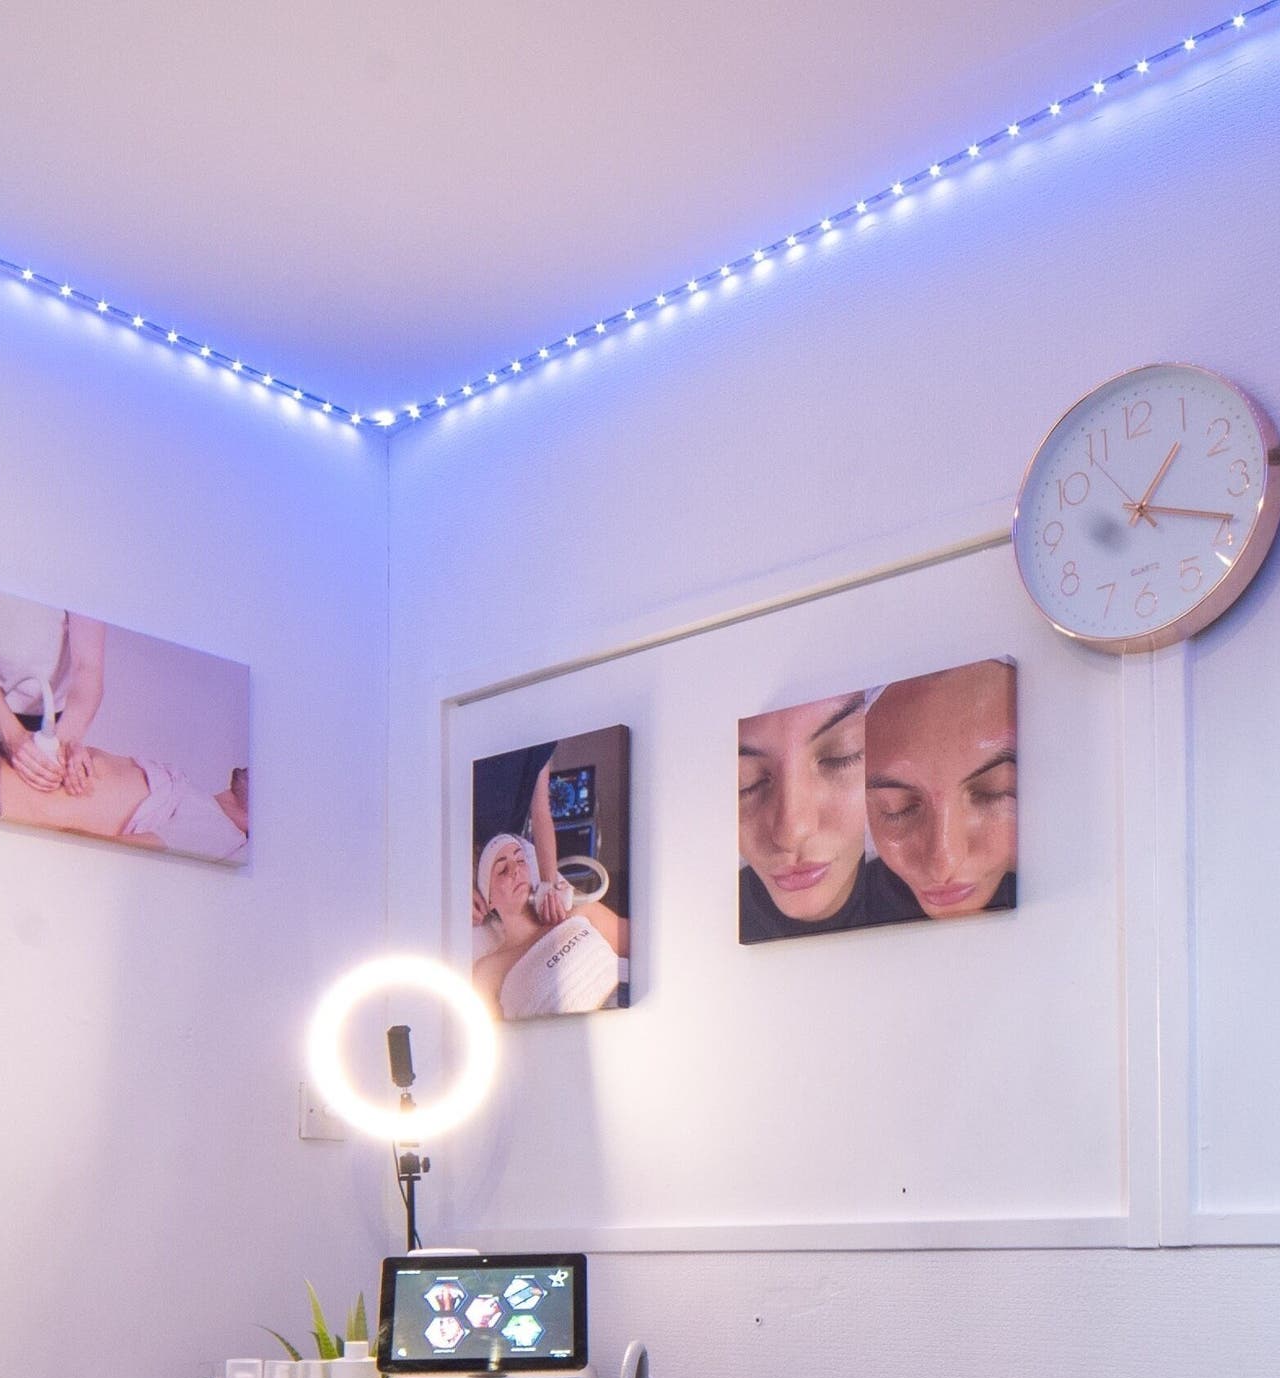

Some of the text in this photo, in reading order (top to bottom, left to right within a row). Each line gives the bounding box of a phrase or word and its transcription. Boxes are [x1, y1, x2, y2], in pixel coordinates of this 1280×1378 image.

[1122, 400, 1152, 440] 12
[1179, 397, 1186, 432] 1
[1086, 429, 1109, 466] 11
[1206, 418, 1231, 457] 2
[1056, 472, 1090, 511] 10
[1227, 459, 1251, 497] 3
[1042, 521, 1064, 554] 9
[1060, 561, 1080, 596] 8
[1179, 556, 1202, 593] 5
[1096, 583, 1116, 620] 7
[1134, 582, 1158, 618] 6
